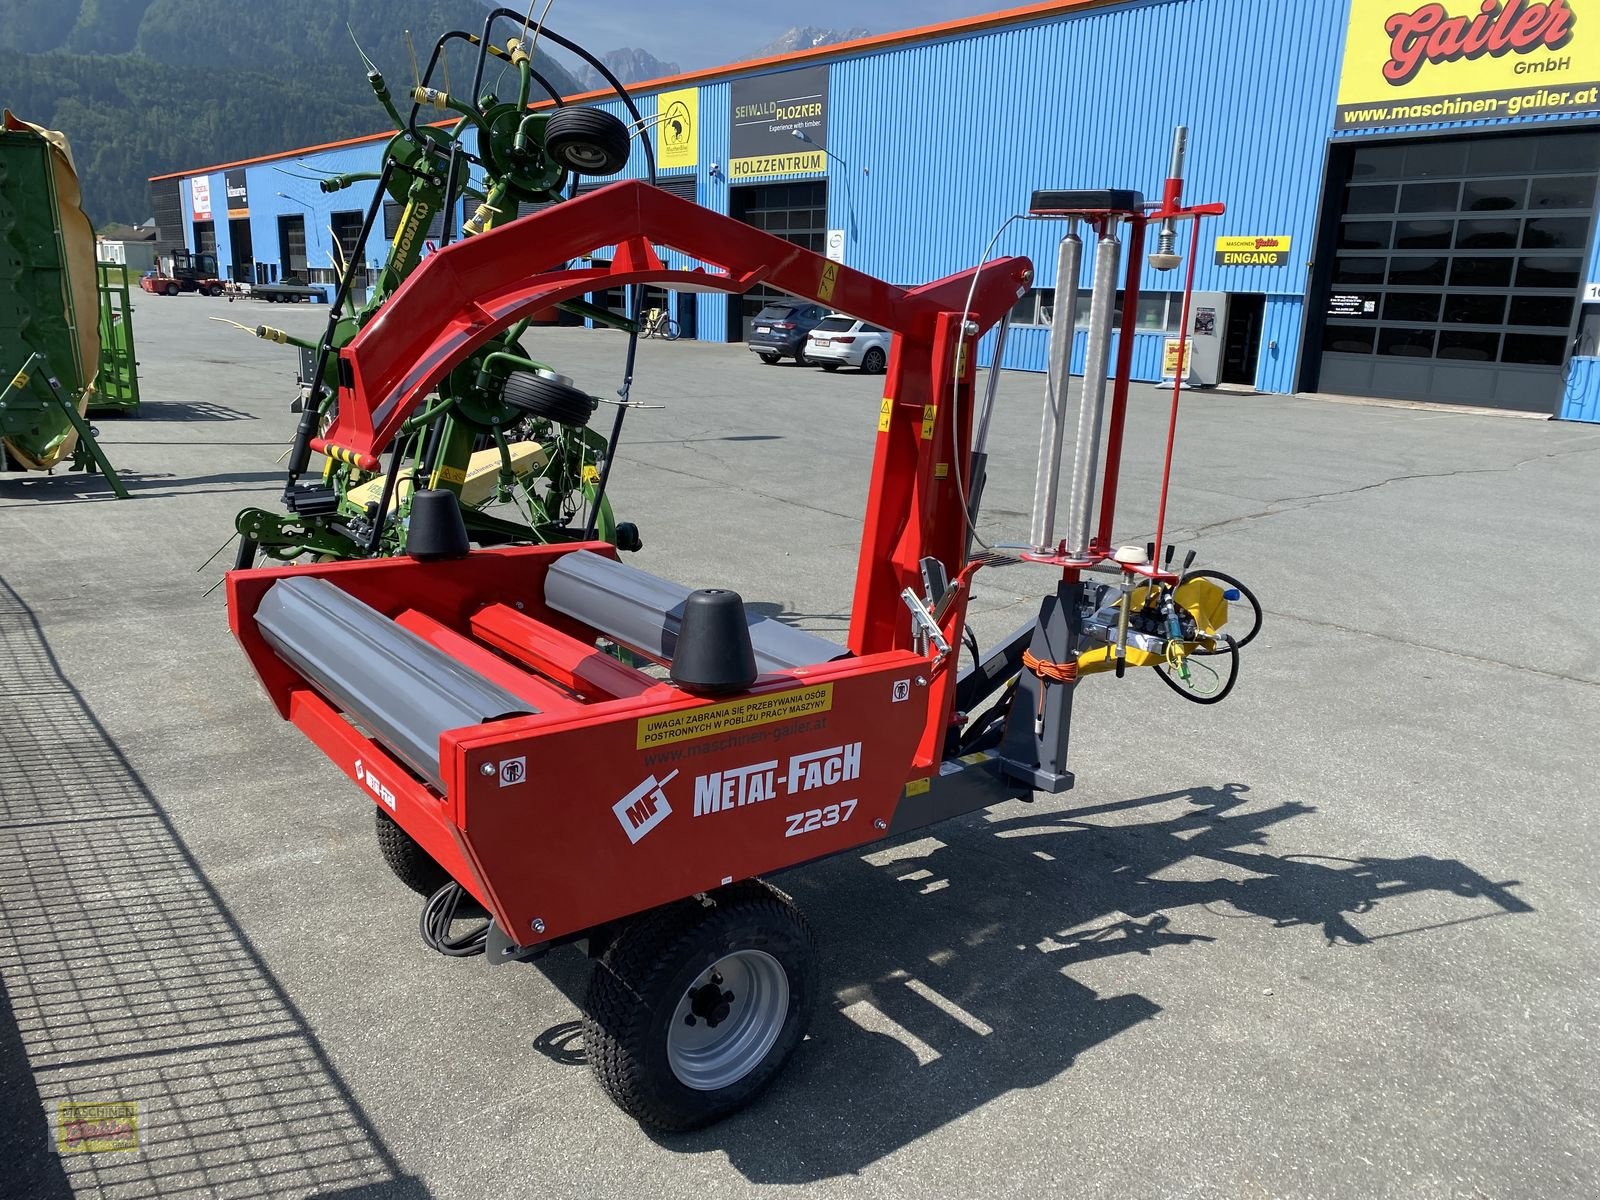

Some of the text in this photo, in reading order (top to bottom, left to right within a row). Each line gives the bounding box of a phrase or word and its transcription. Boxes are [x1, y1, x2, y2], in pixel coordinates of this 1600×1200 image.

[1382, 0, 1577, 86] Gailer
[1514, 57, 1571, 74] GmbH
[735, 101, 776, 119] SEIWALD
[1344, 87, 1598, 123] www.maschinen-gailer.at
[769, 124, 793, 132] Experience
[734, 155, 821, 175] HOLZZENTRUM
[393, 216, 420, 272] KRONE
[1223, 252, 1278, 264] EINGANG
[644, 722, 712, 743] POSTRONNYCH
[713, 720, 722, 729] W
[760, 708, 788, 720] PRACY
[789, 700, 826, 714] MASZYNY
[647, 718, 684, 732] UWAGA!
[686, 709, 730, 724] ZABRANIA
[746, 695, 802, 713] PRZEBYWANIA
[804, 690, 826, 701] OSÓB
[644, 717, 826, 766] www.maschinen-gailer.at
[785, 799, 858, 838] Z237
